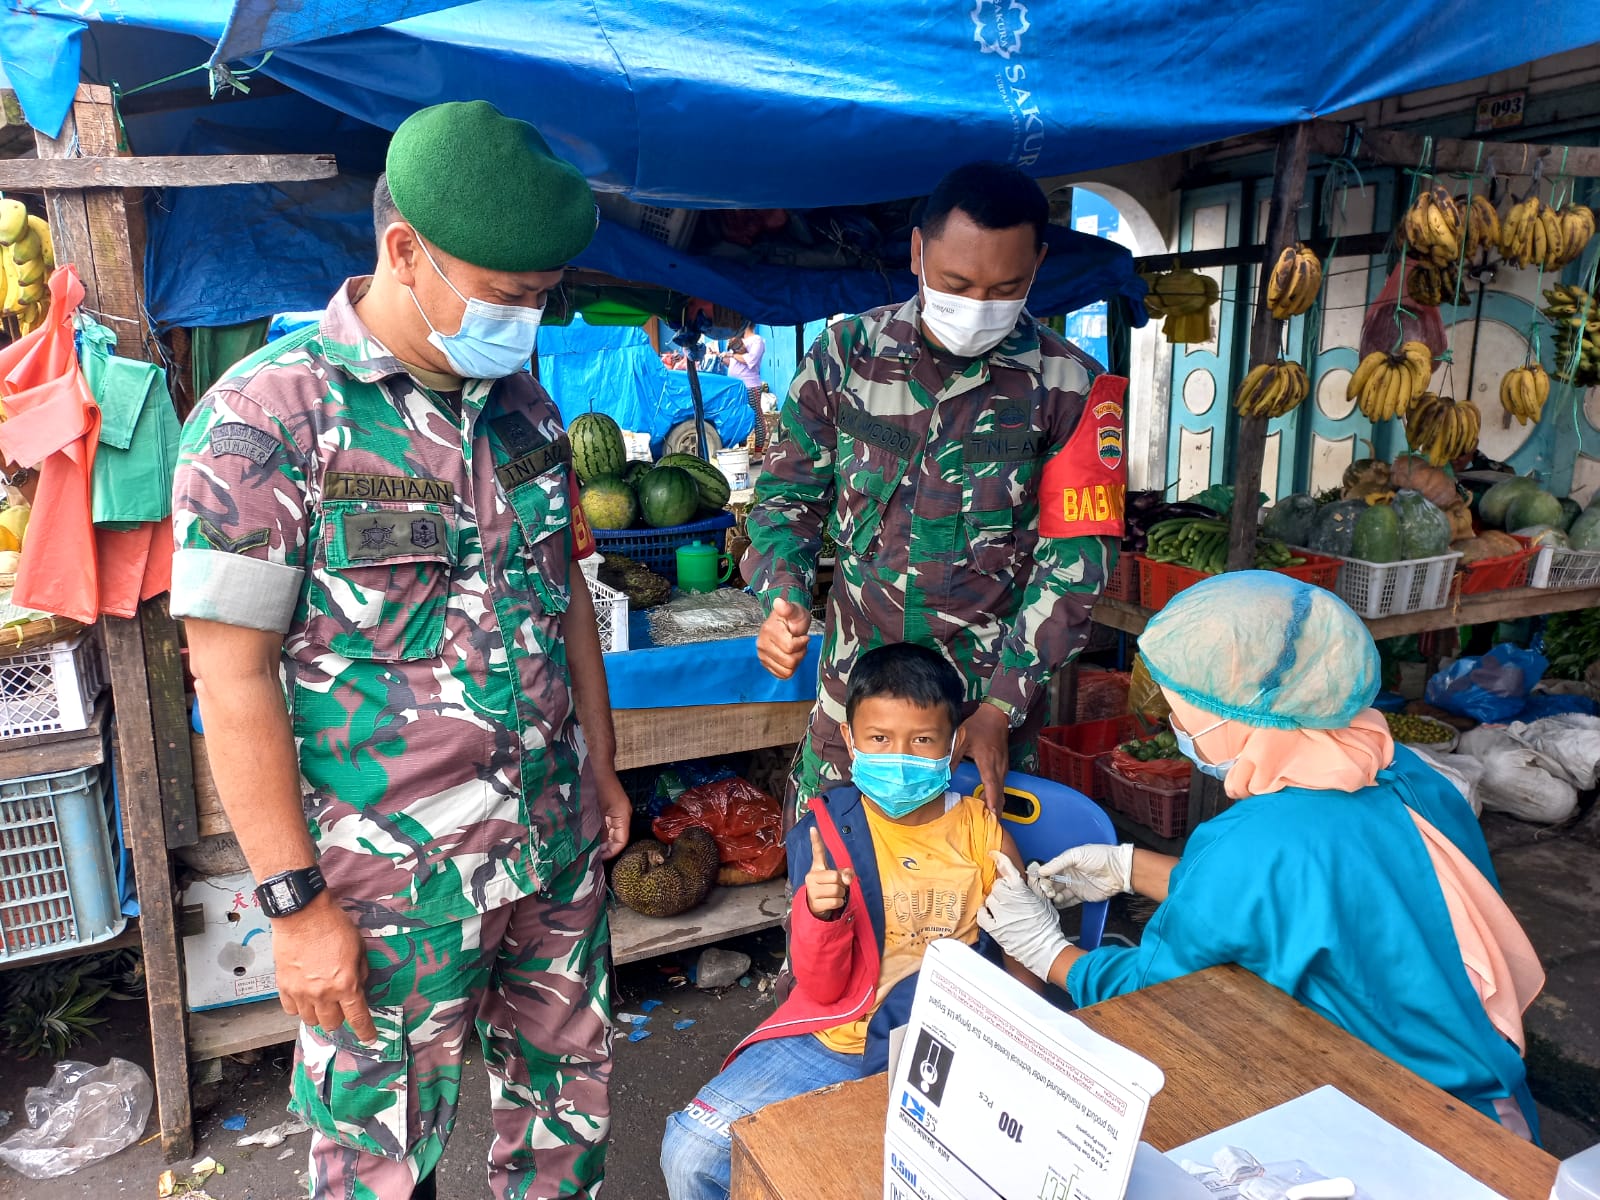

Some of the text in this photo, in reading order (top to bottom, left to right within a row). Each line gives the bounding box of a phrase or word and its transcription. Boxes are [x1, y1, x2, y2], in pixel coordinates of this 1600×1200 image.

[1491, 97, 1521, 117] 093
[504, 459, 536, 482] TNI
[340, 477, 450, 500] T.SIAHAAN
[928, 992, 947, 1014] England
[954, 1011, 972, 1032] Syringe
[981, 1032, 994, 1048] from
[1009, 1052, 1032, 1076] technical
[1031, 1068, 1046, 1087] under
[1045, 1078, 1081, 1112] manufactured
[977, 1089, 1025, 1146] 100 Pcs
[1085, 1106, 1107, 1131] product
[1105, 1122, 1119, 1140] This
